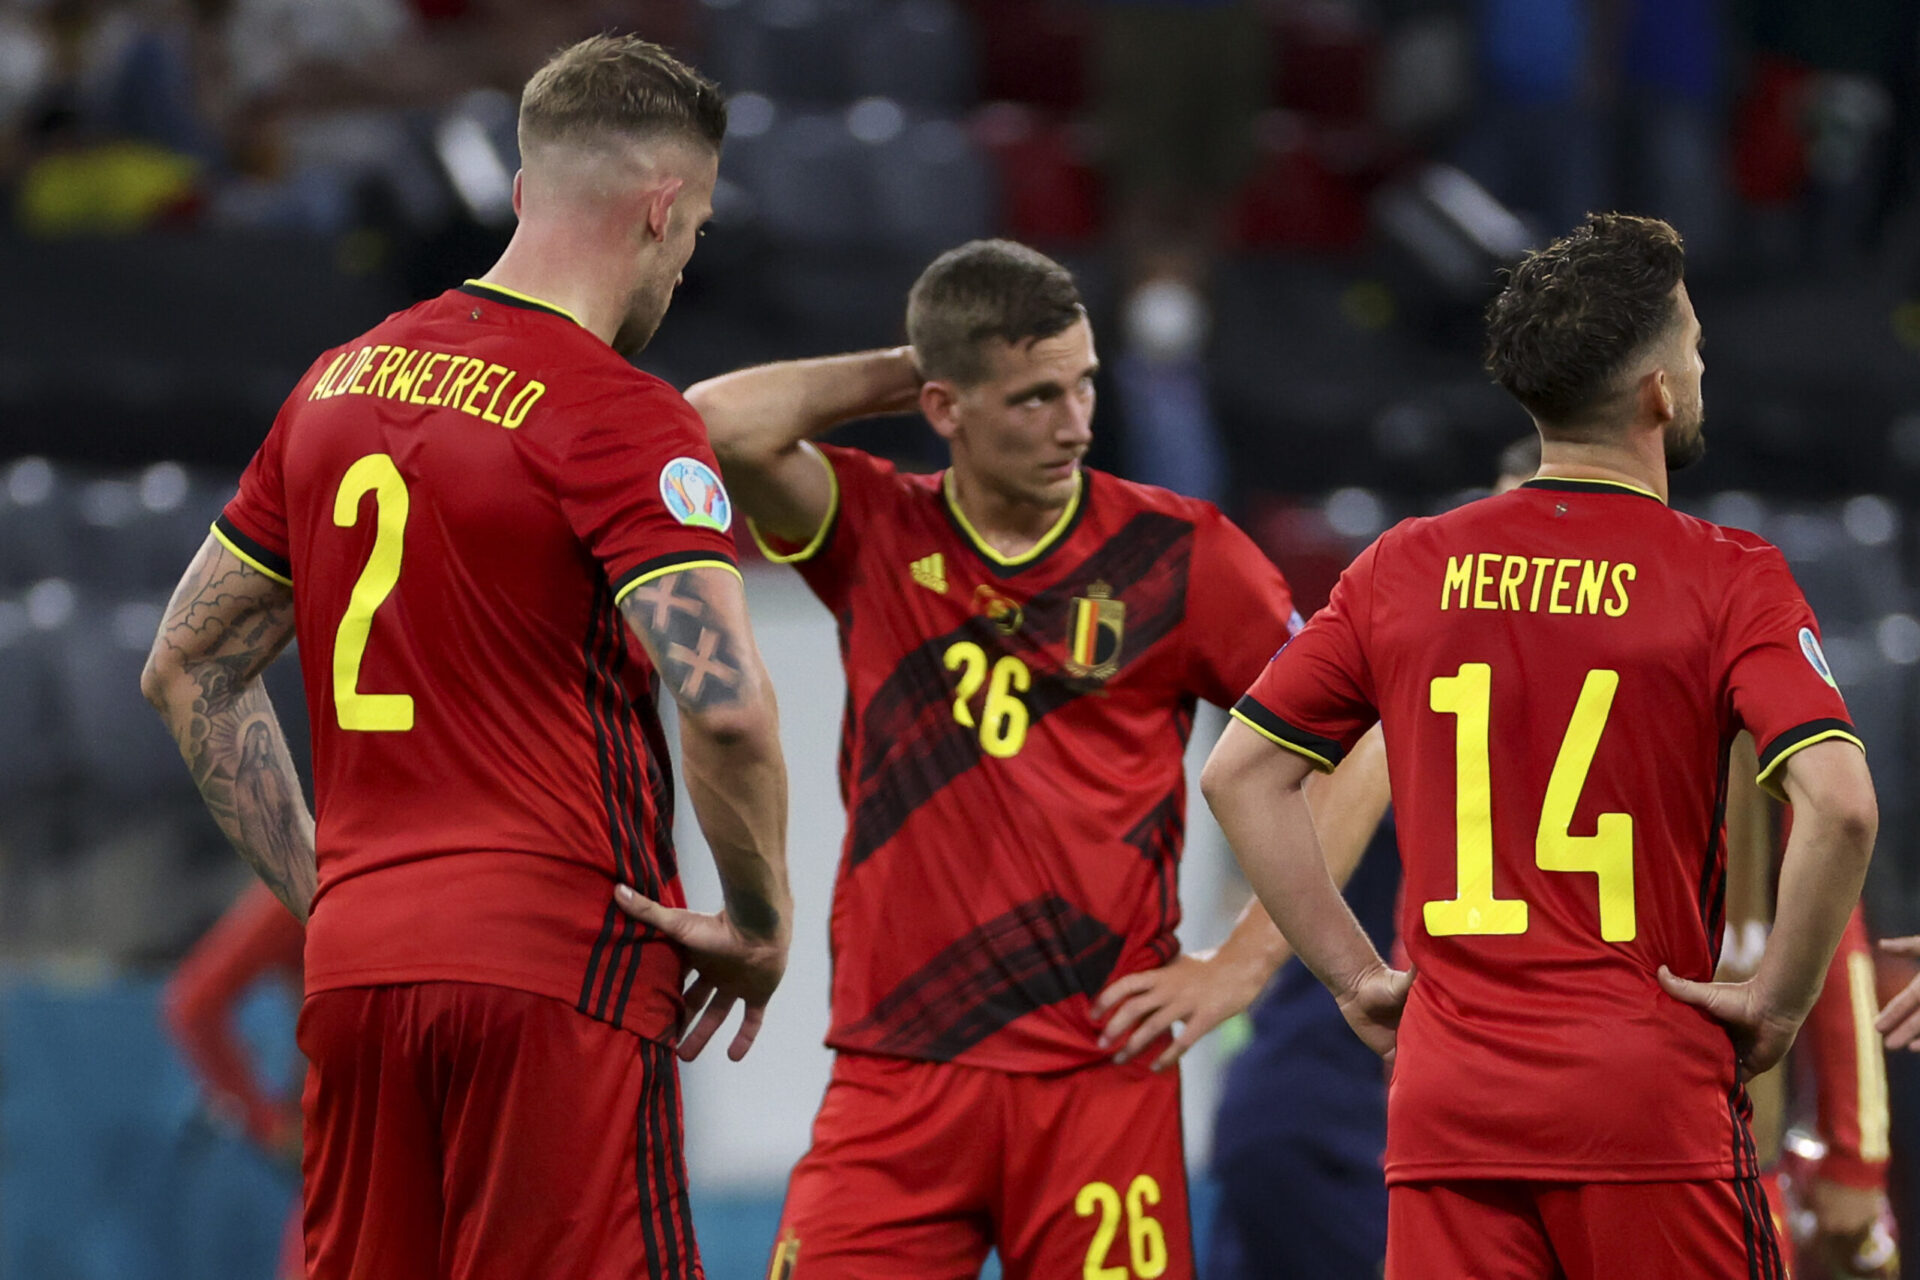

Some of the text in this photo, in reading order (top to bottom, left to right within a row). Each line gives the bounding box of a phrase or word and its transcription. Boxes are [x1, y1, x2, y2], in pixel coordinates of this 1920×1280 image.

[307, 343, 547, 430] ALDERWEIRELD
[332, 453, 414, 732] 2
[1440, 552, 1638, 618] MERTENS
[943, 640, 1030, 759] 26
[1422, 662, 1638, 943] 14
[1075, 1174, 1168, 1280] 26
